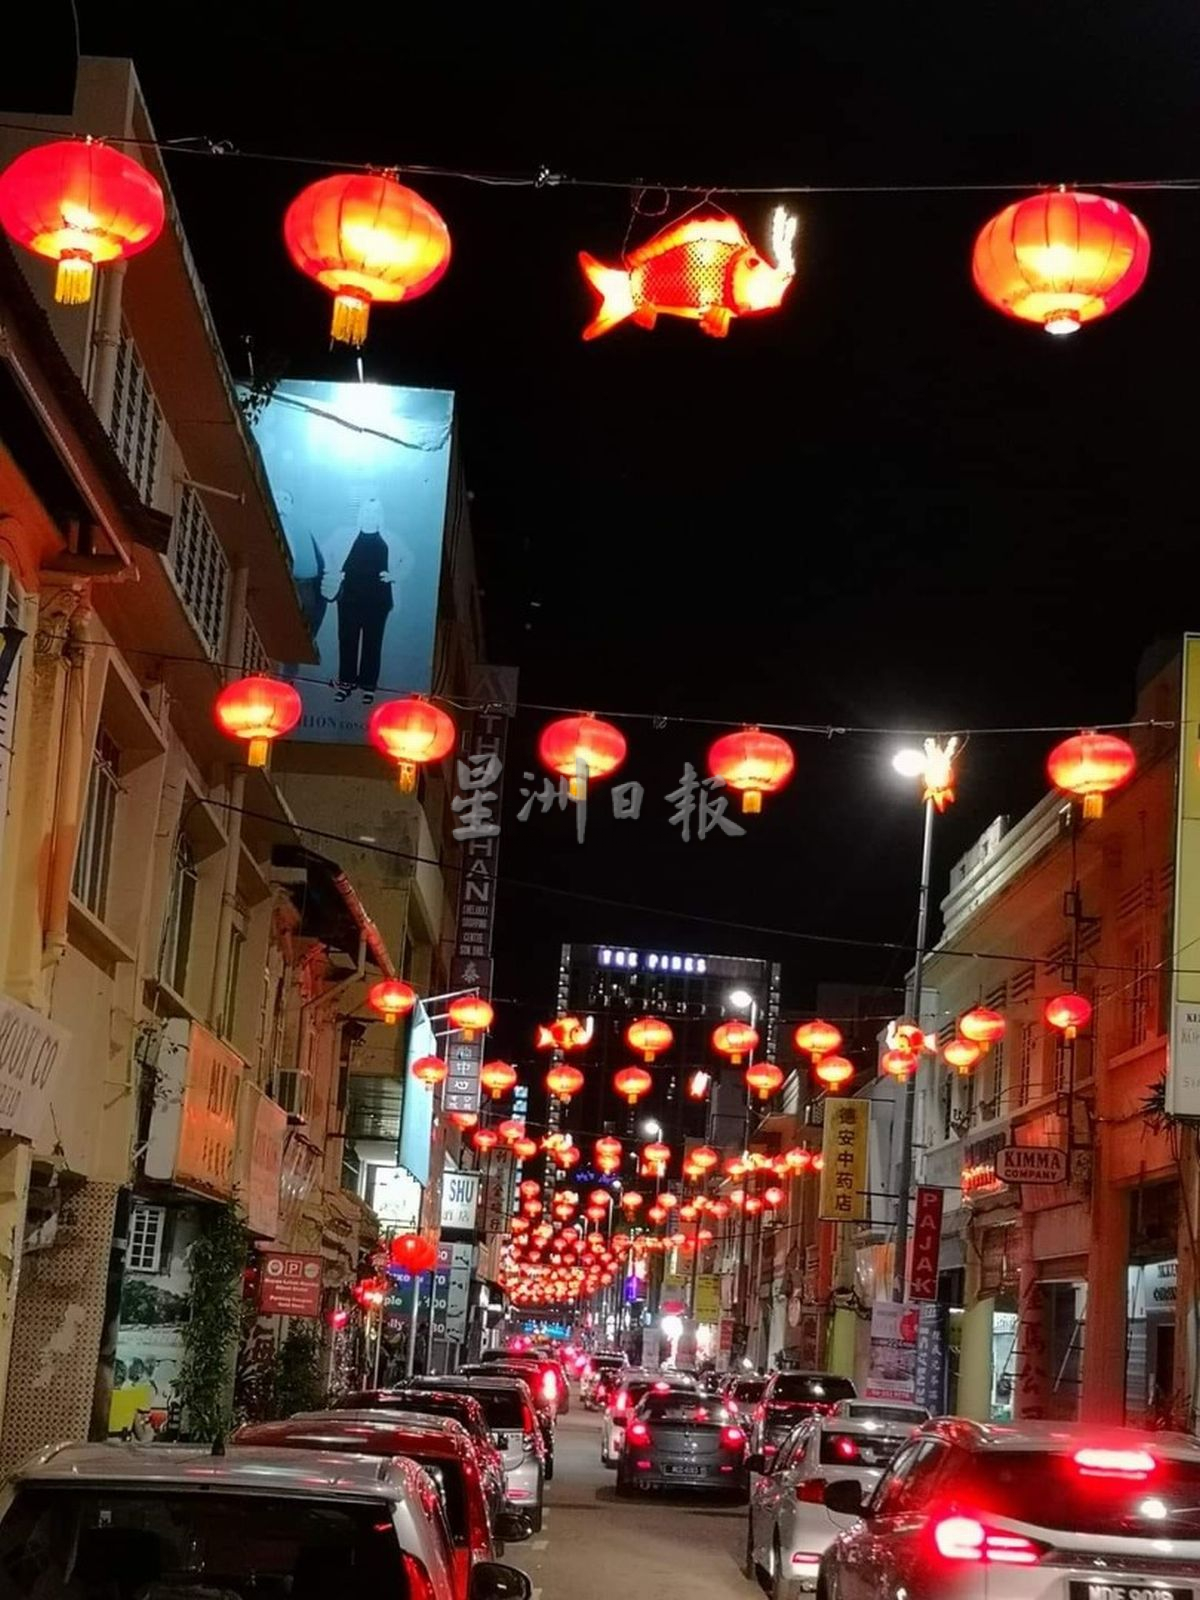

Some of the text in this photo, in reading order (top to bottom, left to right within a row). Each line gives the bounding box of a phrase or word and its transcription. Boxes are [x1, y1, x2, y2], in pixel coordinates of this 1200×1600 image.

[834, 1107, 857, 1212] 德安中药店
[1004, 1151, 1061, 1170] KIMMA
[1004, 1168, 1058, 1180] COMPANY
[449, 1179, 475, 1204] SHU
[912, 1193, 938, 1293] PAJAK
